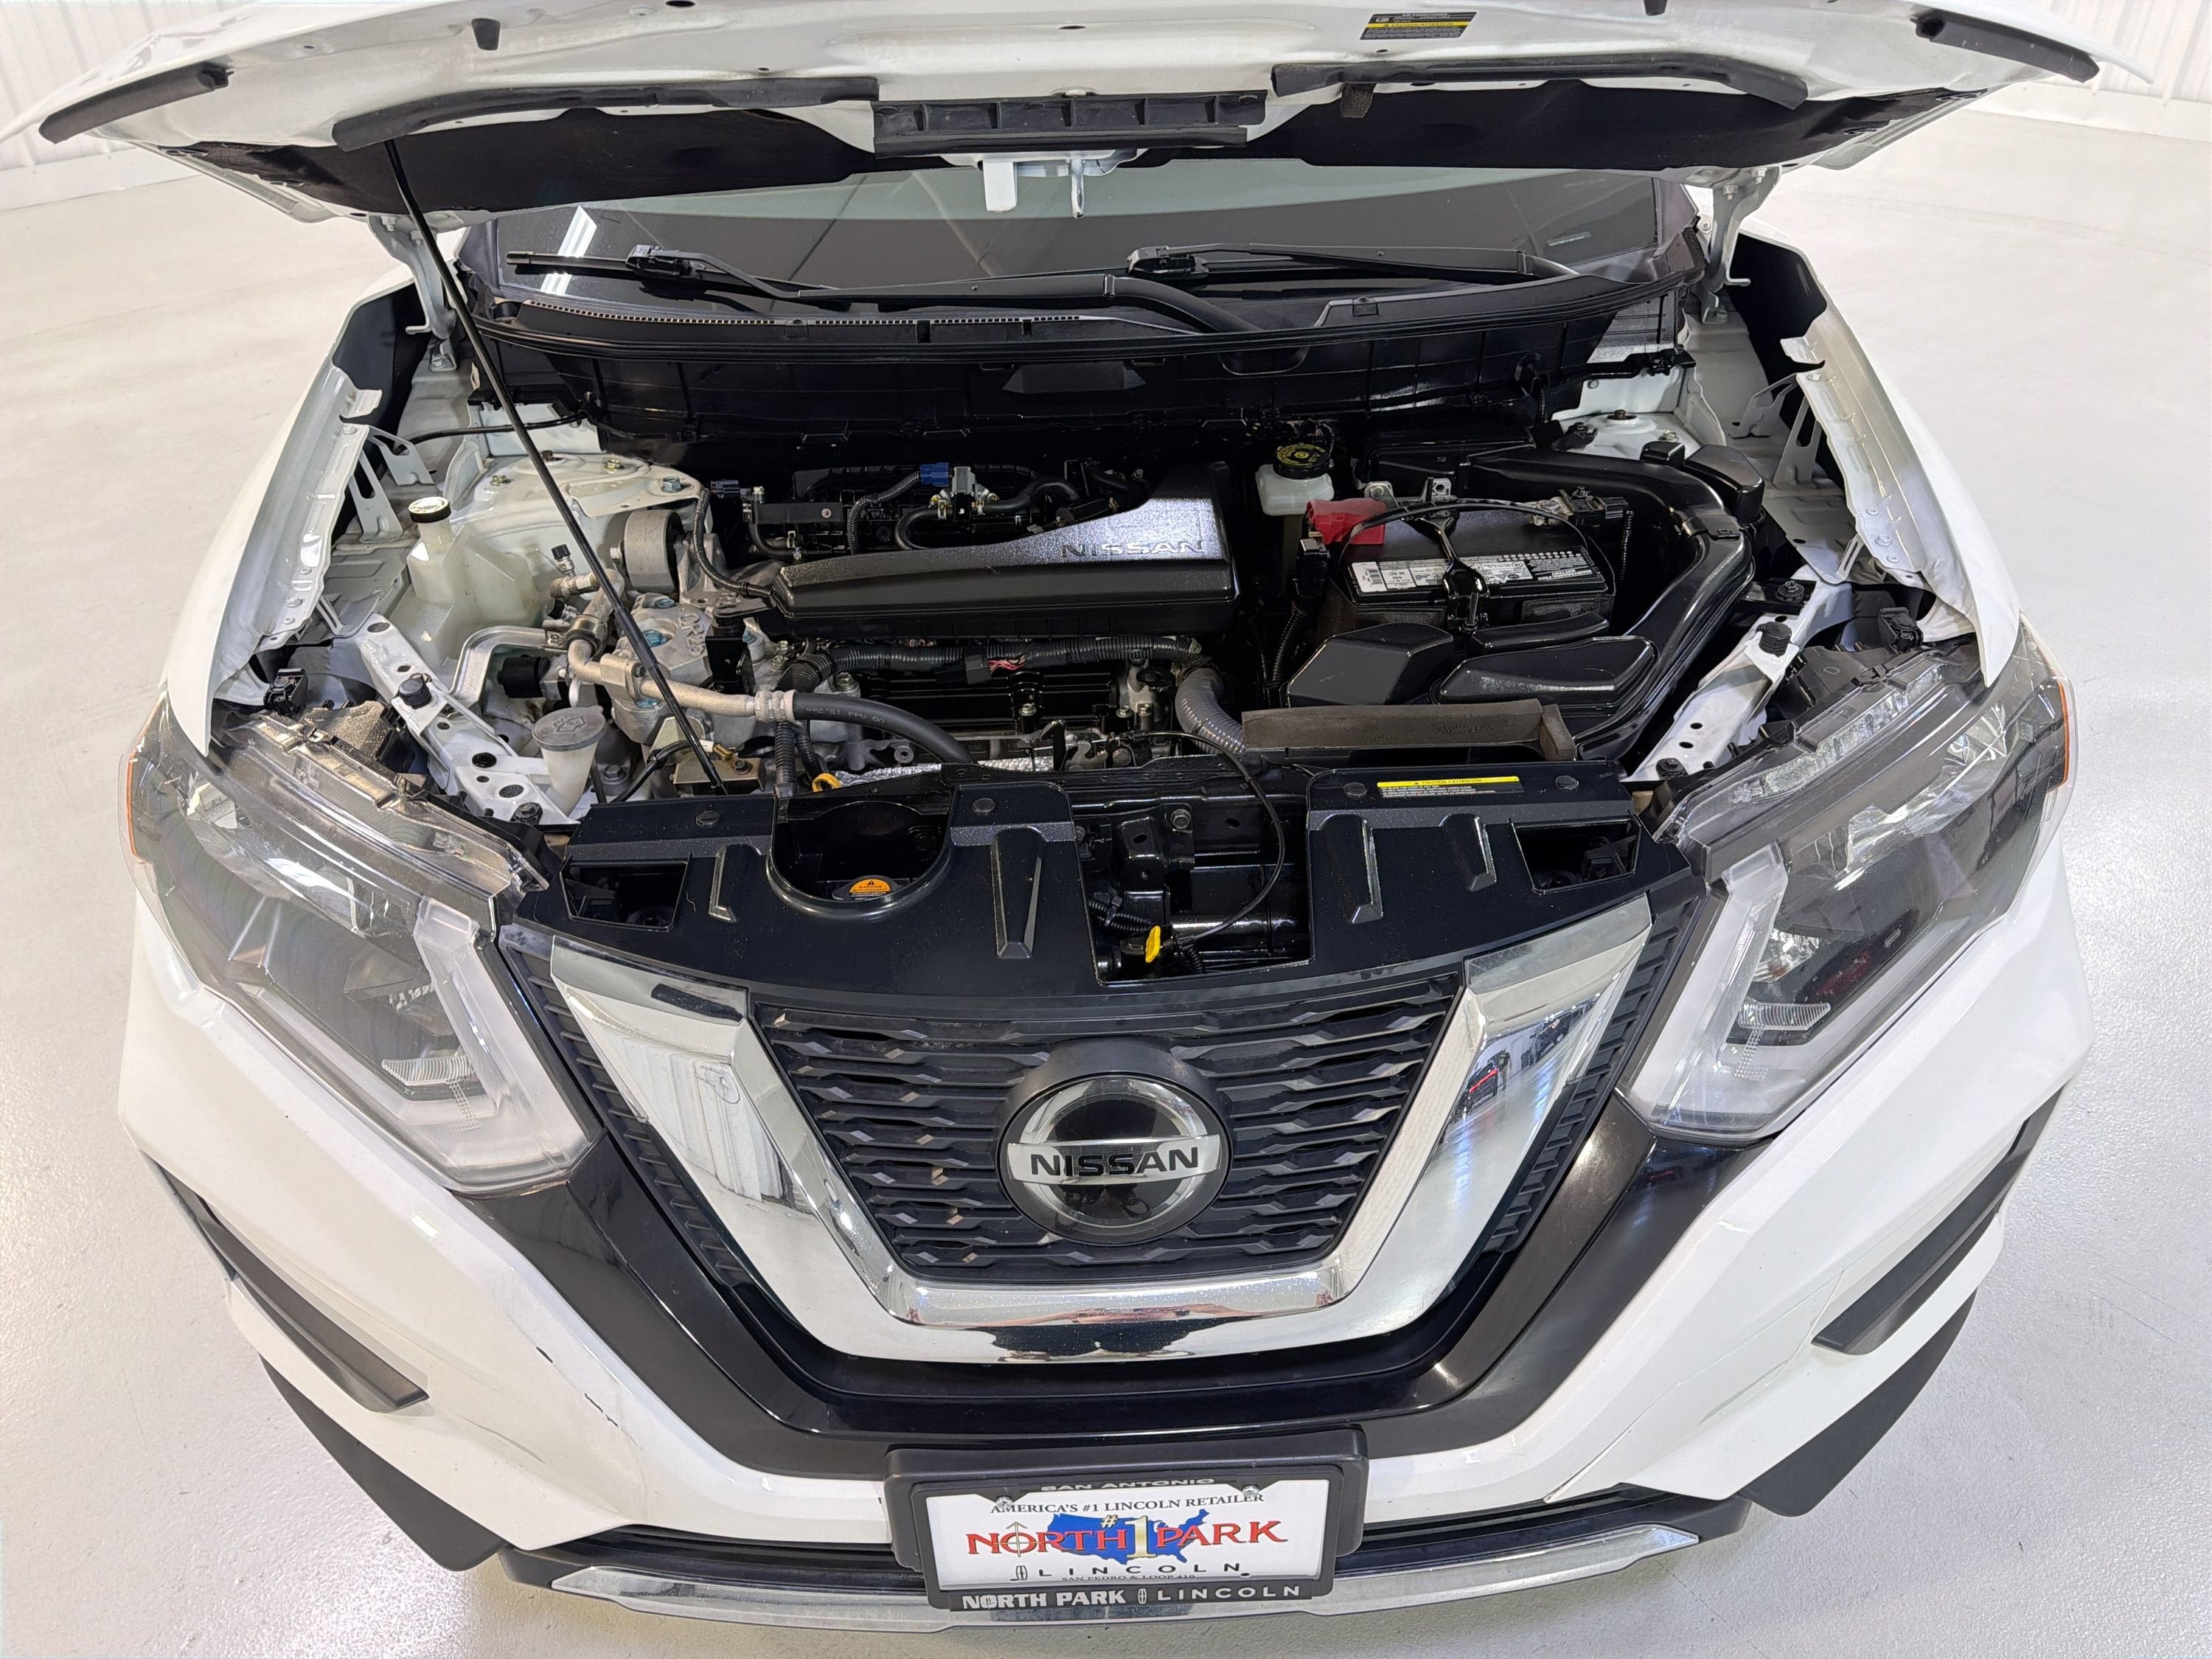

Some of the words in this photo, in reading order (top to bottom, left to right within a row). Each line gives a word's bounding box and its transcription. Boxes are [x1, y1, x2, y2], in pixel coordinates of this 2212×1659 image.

[1060, 540, 1206, 557] NISSAN
[1031, 1147, 1198, 1176] NISSAN
[1101, 1478, 1214, 1489] ANTONIO
[990, 1503, 1077, 1514] AMERICA'S
[1082, 1503, 1098, 1512] #1
[1105, 1499, 1180, 1512] LINCOLN
[1186, 1494, 1265, 1507] RETAILER
[965, 1528, 1128, 1555] NORTH
[1156, 1520, 1289, 1548] PARK
[1038, 1562, 1241, 1576] LINCOLN
[961, 1593, 1047, 1610] NORTH
[1056, 1589, 1127, 1607] PARK
[1158, 1585, 1300, 1601] LINCOLN
